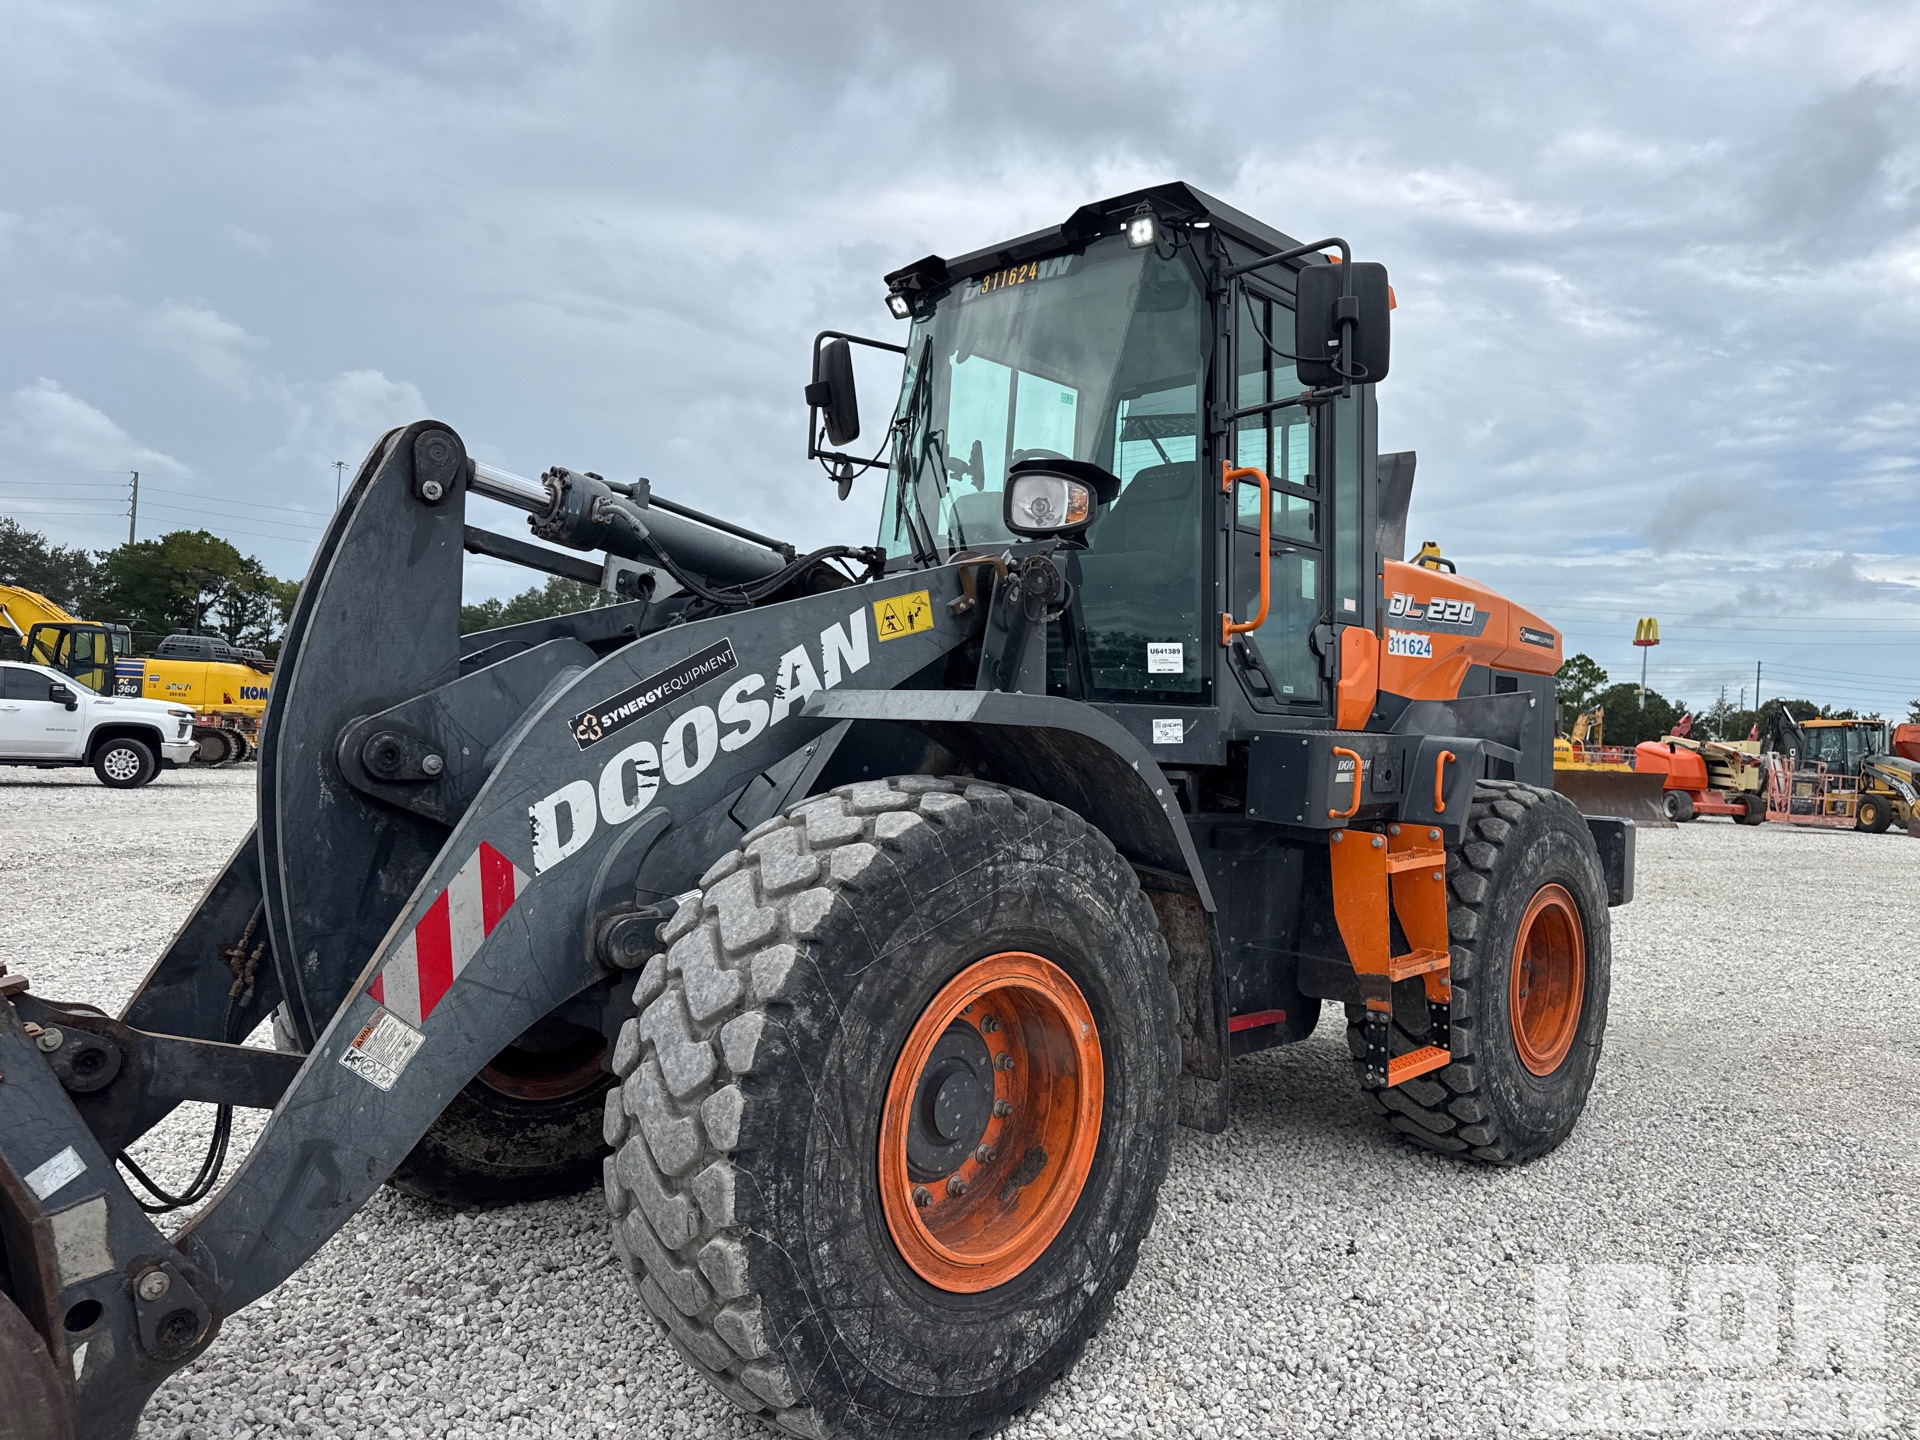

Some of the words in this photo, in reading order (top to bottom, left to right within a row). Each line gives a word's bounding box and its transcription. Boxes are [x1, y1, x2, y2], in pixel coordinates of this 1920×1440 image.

[981, 261, 1038, 294] 311624
[1388, 592, 1424, 620] DL
[1426, 597, 1475, 626] 220
[1389, 636, 1431, 656] 311624
[117, 684, 138, 694] 360
[240, 686, 269, 700] KOM
[527, 606, 871, 877] DOOSAN
